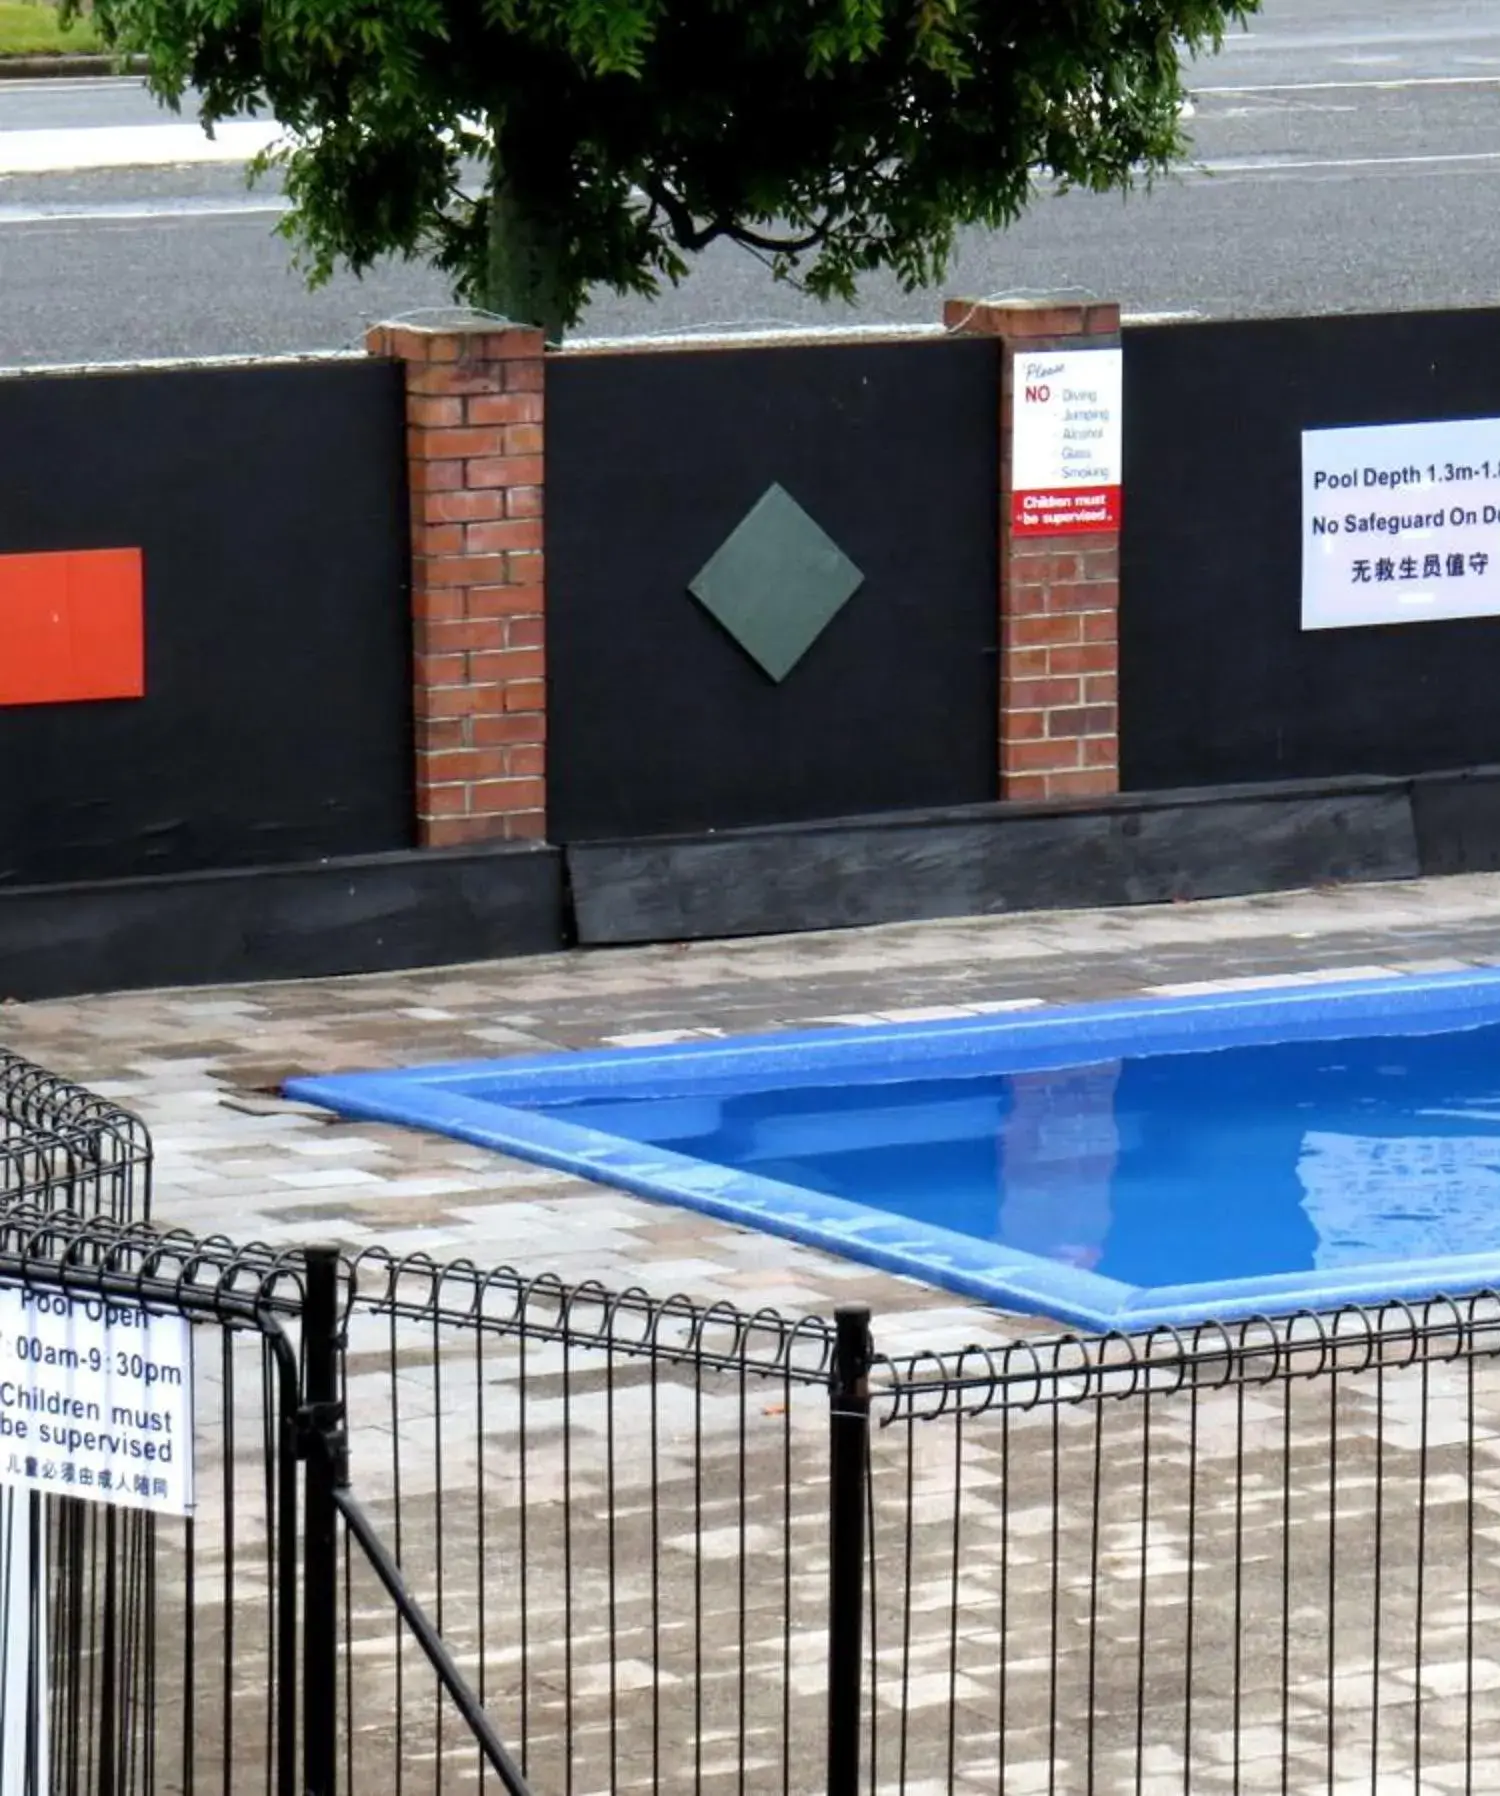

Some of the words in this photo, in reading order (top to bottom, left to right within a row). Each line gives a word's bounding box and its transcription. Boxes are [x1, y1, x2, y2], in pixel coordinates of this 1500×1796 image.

[1024, 363, 1065, 381] Please
[1025, 385, 1050, 403] NO
[1063, 388, 1098, 402] Diving
[1062, 408, 1109, 422] Jumping
[1062, 427, 1103, 440] Alcohol
[1061, 447, 1091, 460] Glass
[1061, 466, 1109, 480] Smoking
[1314, 469, 1358, 489] Pool
[1363, 465, 1421, 489] Depth
[1024, 495, 1071, 509] Children
[1075, 494, 1105, 507] must
[1023, 512, 1038, 525] be
[1043, 509, 1105, 525] supervised
[1312, 517, 1339, 534] No
[1344, 510, 1444, 534] Safeguard
[1450, 507, 1477, 525] On
[1351, 552, 1489, 584] 无救生员值守
[21, 1290, 73, 1317] Pool
[84, 1300, 149, 1329] Open
[0, 1381, 100, 1420] Children
[111, 1406, 172, 1433] must
[0, 1412, 28, 1438] be
[40, 1423, 173, 1463] supervised
